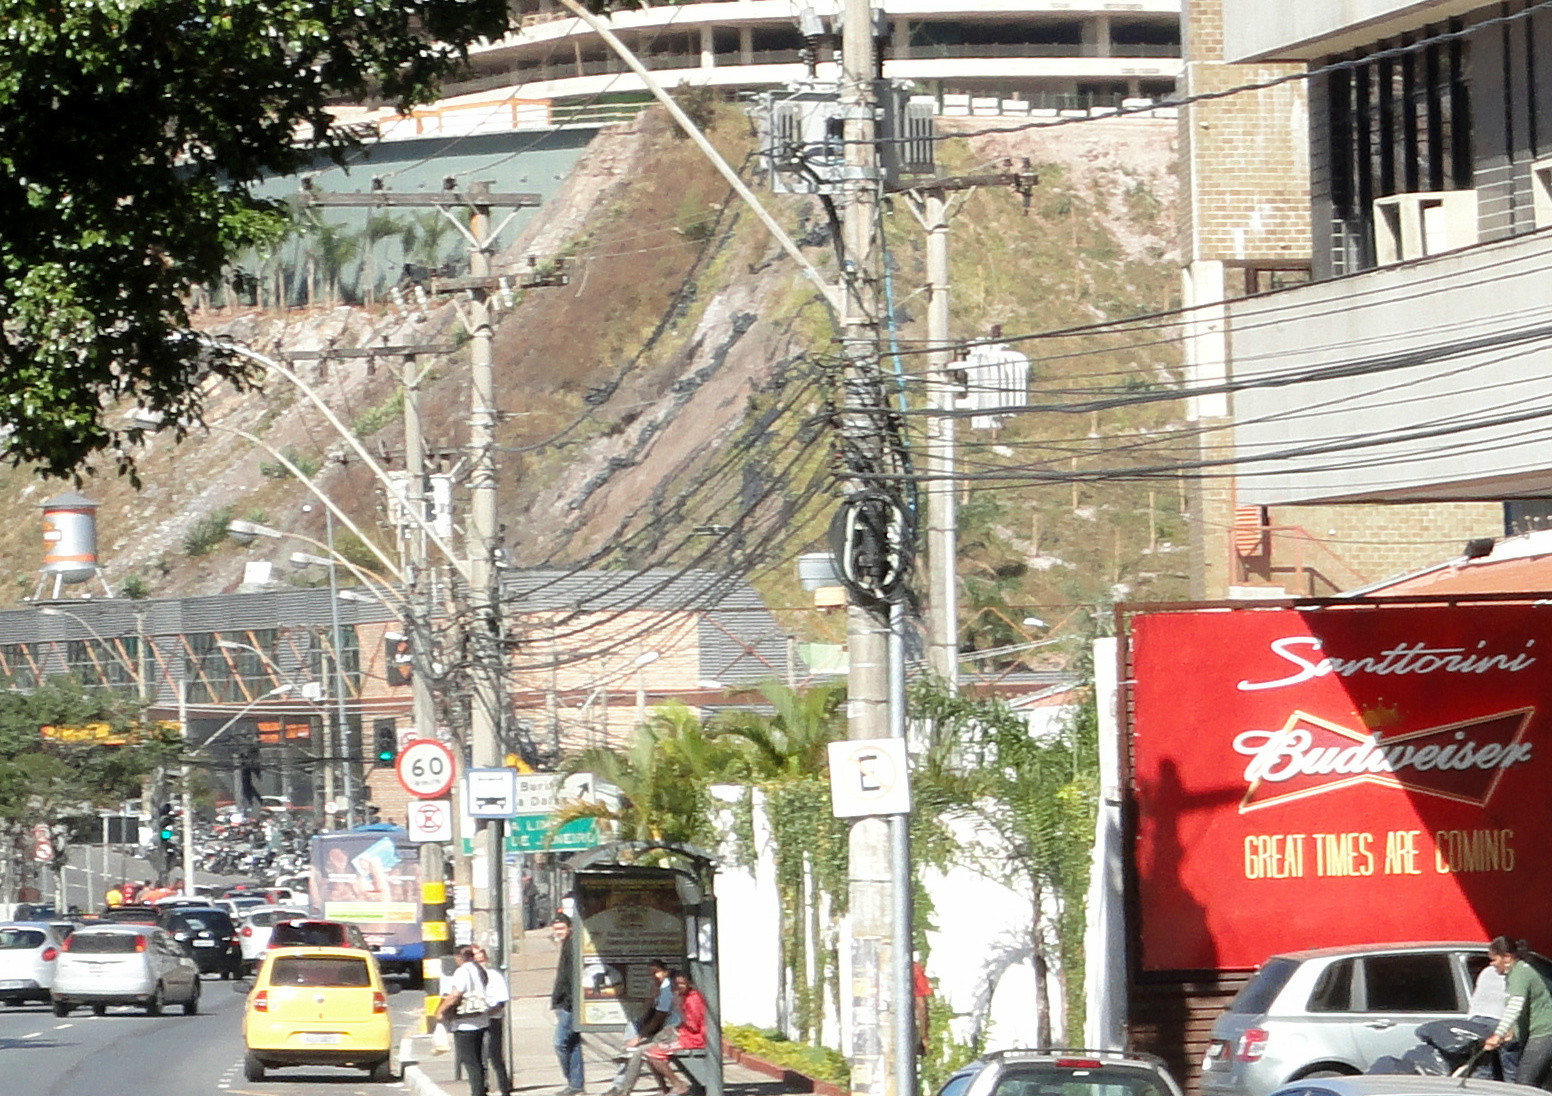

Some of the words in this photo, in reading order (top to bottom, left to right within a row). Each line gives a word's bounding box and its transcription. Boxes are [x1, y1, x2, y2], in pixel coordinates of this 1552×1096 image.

[1237, 636, 1536, 691] Santtorini
[411, 756, 444, 777] 60
[1233, 729, 1532, 782] Budweiser
[1243, 832, 1306, 879] GREAT
[1312, 832, 1374, 877] TIMES
[1384, 830, 1422, 875] ARE
[1436, 829, 1515, 873] COMING
